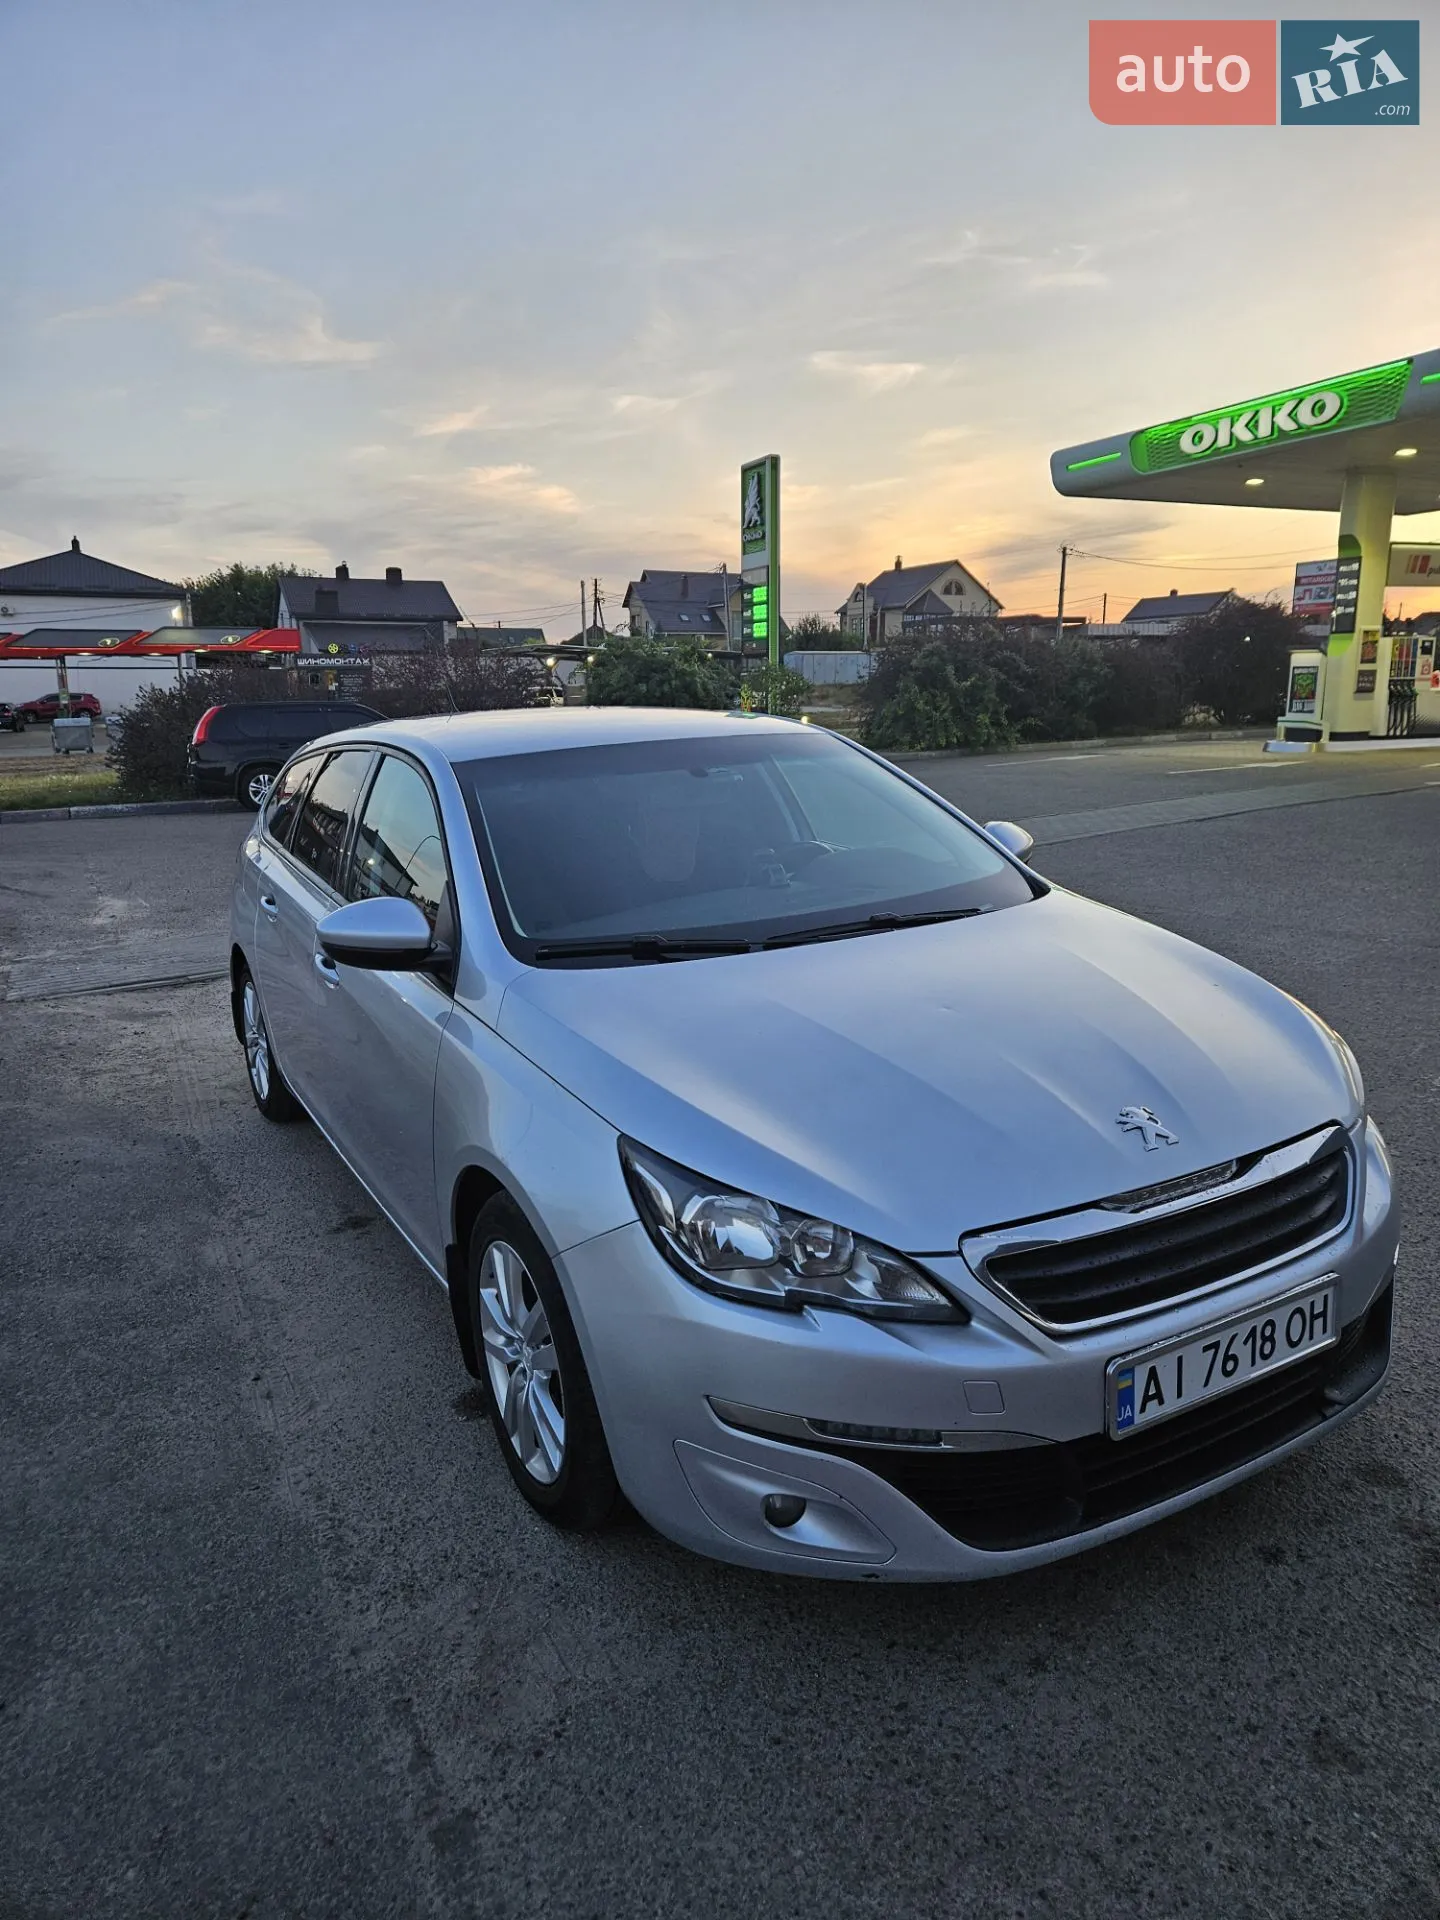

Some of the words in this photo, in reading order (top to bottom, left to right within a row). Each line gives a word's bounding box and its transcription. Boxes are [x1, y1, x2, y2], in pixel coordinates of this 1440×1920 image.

[1180, 391, 1341, 454] OKKO
[297, 657, 371, 665] ШИНОМОНТАЖ
[1139, 1355, 1184, 1414] AI
[1202, 1318, 1277, 1388] 7618
[1285, 1293, 1329, 1348] OH
[1117, 1404, 1133, 1422] UA
